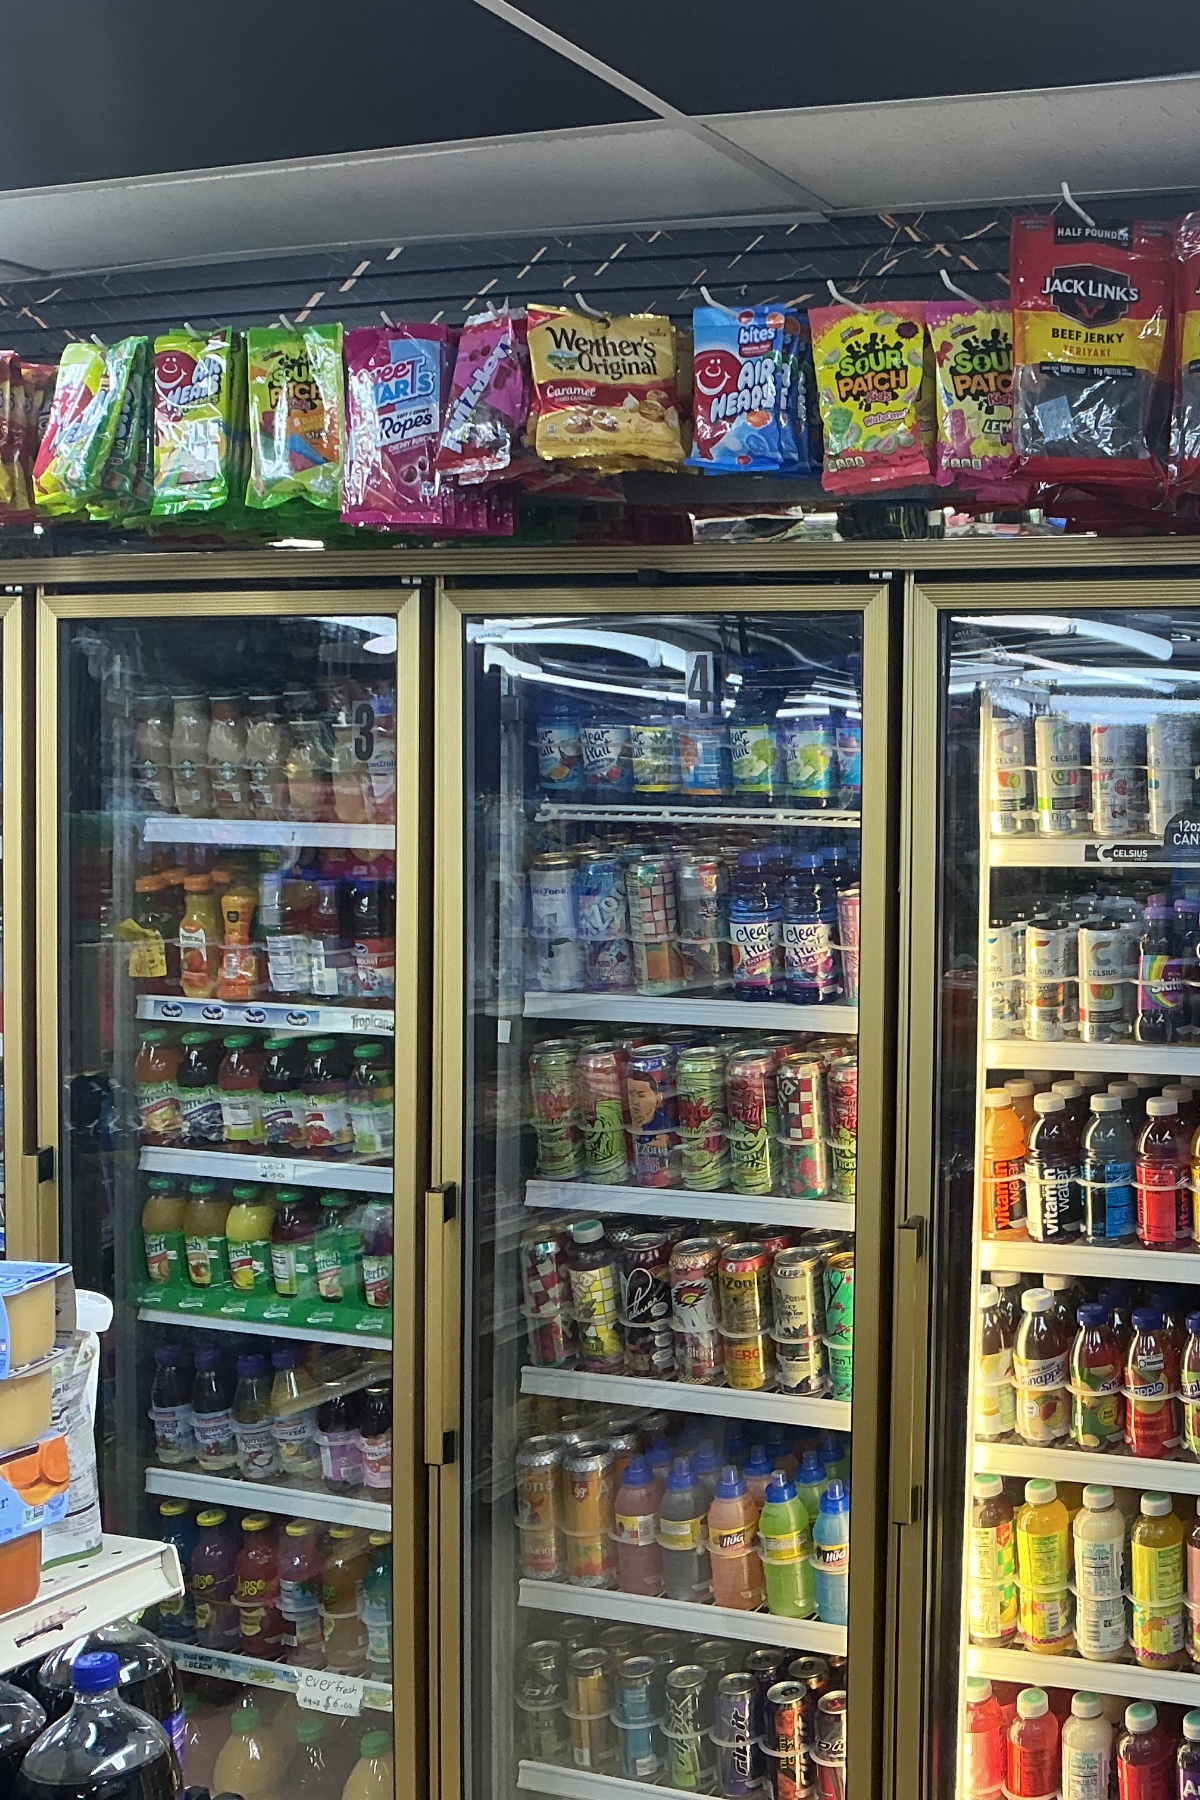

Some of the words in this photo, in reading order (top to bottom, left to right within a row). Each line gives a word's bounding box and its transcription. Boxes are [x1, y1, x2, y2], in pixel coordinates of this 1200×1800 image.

[1057, 228, 1082, 237] HALF
[1041, 276, 1087, 297] JACK
[1088, 280, 1139, 302] LINK'S
[546, 326, 657, 359] Werther's
[739, 326, 776, 344] bites
[1052, 327, 1082, 341] BEEF
[1084, 331, 1125, 344] JERKY
[839, 350, 903, 377] SOUR
[954, 351, 1012, 374] SOU
[1063, 344, 1111, 358] TERIYAKI
[577, 352, 658, 380] Original
[738, 358, 775, 391] AIR
[546, 385, 597, 398] Caramel
[837, 370, 908, 398] PATCH
[953, 371, 1012, 397] PATC
[710, 384, 776, 424] HEADS
[379, 413, 433, 440] Ropes
[688, 655, 711, 714] 4
[354, 702, 375, 760] 3
[995, 756, 1022, 765] CELSIUS
[1050, 754, 1078, 763] CELSIUS
[1113, 849, 1148, 858] CELSIUS
[735, 923, 772, 944] Clear
[786, 925, 822, 944] Clear
[1088, 968, 1117, 977] CELSIUS
[350, 1014, 395, 1032] Tropicana
[994, 1161, 1009, 1228] vitamin
[1008, 1160, 1020, 1206] water
[1057, 1168, 1071, 1212] water
[1042, 1166, 1058, 1235] vitamin
[188, 1661, 213, 1671] BEACH
